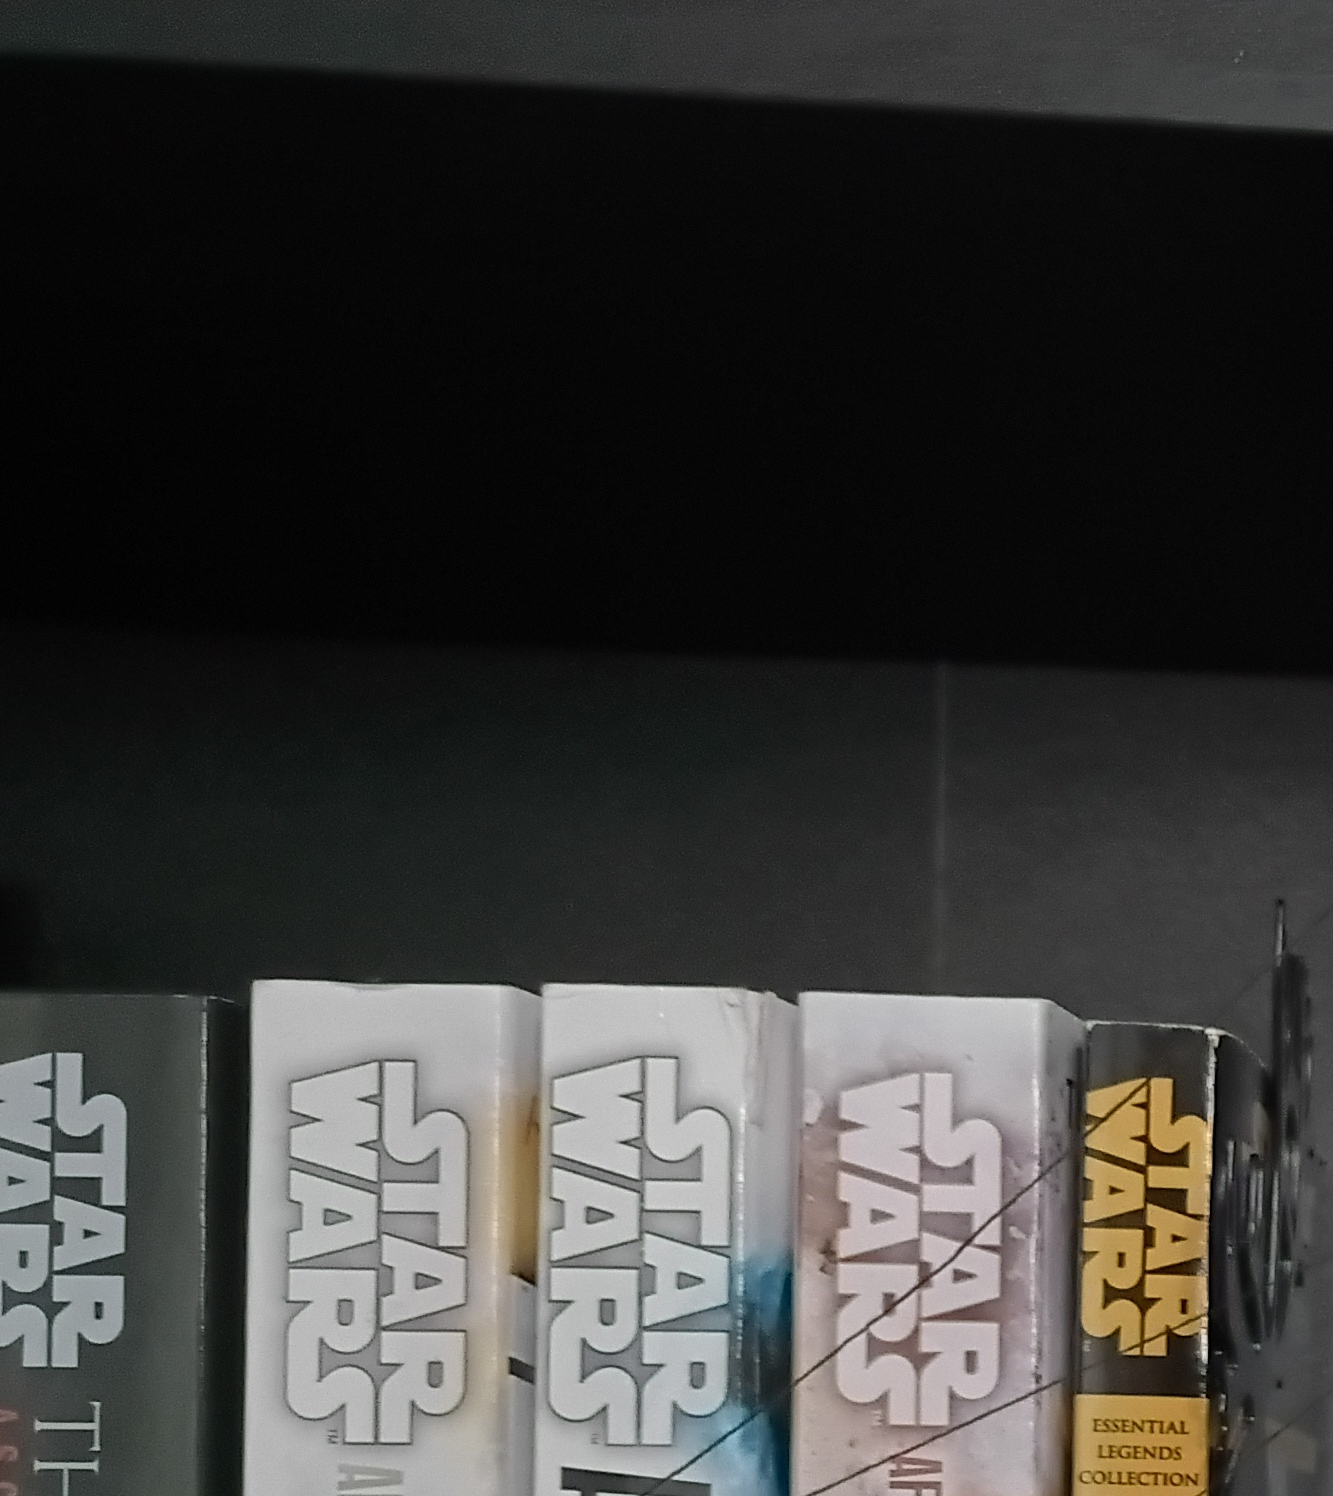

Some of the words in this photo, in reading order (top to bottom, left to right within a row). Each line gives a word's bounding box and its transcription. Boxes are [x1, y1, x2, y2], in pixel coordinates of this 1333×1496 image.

[51, 1052, 127, 1368] STAR
[286, 1059, 379, 1445] WARS
[379, 1059, 470, 1445] STAR
[548, 1055, 641, 1446] WARS
[641, 1055, 731, 1446] STAR
[837, 1073, 920, 1425] WARS
[920, 1073, 1002, 1425] STAR
[1081, 1077, 1147, 1356] WARS
[1144, 1077, 1208, 1356] STAR
[1079, 1469, 1200, 1487] COLLECTION
[1092, 1418, 1190, 1435] ESSENTIAL
[1097, 1444, 1183, 1461] LEGENDS
